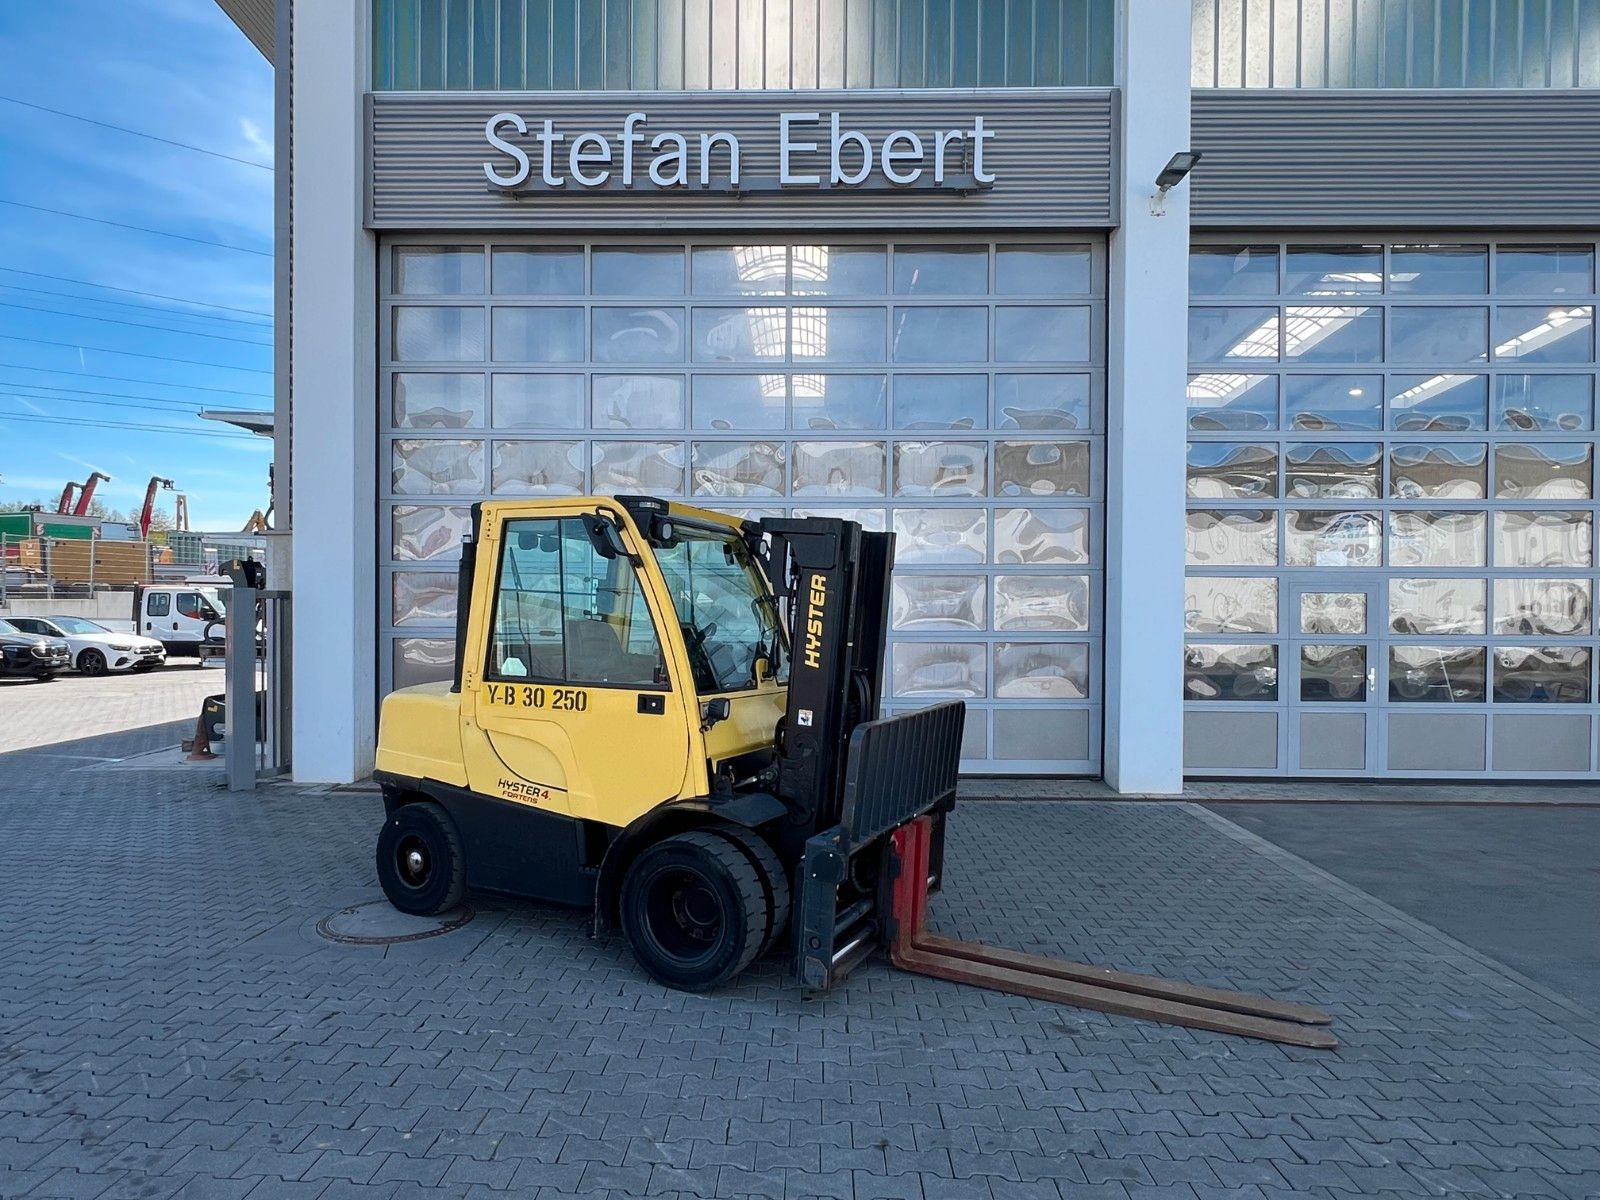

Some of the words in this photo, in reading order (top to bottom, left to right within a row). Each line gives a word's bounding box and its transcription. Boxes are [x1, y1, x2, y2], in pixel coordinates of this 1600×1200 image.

[482, 112, 739, 186] Stefan
[779, 112, 996, 187] Ebert
[804, 573, 827, 669] HYSTER
[487, 684, 515, 706] Y-B
[522, 687, 545, 708] 30
[551, 689, 588, 712] 250
[497, 778, 541, 798] HYSTER
